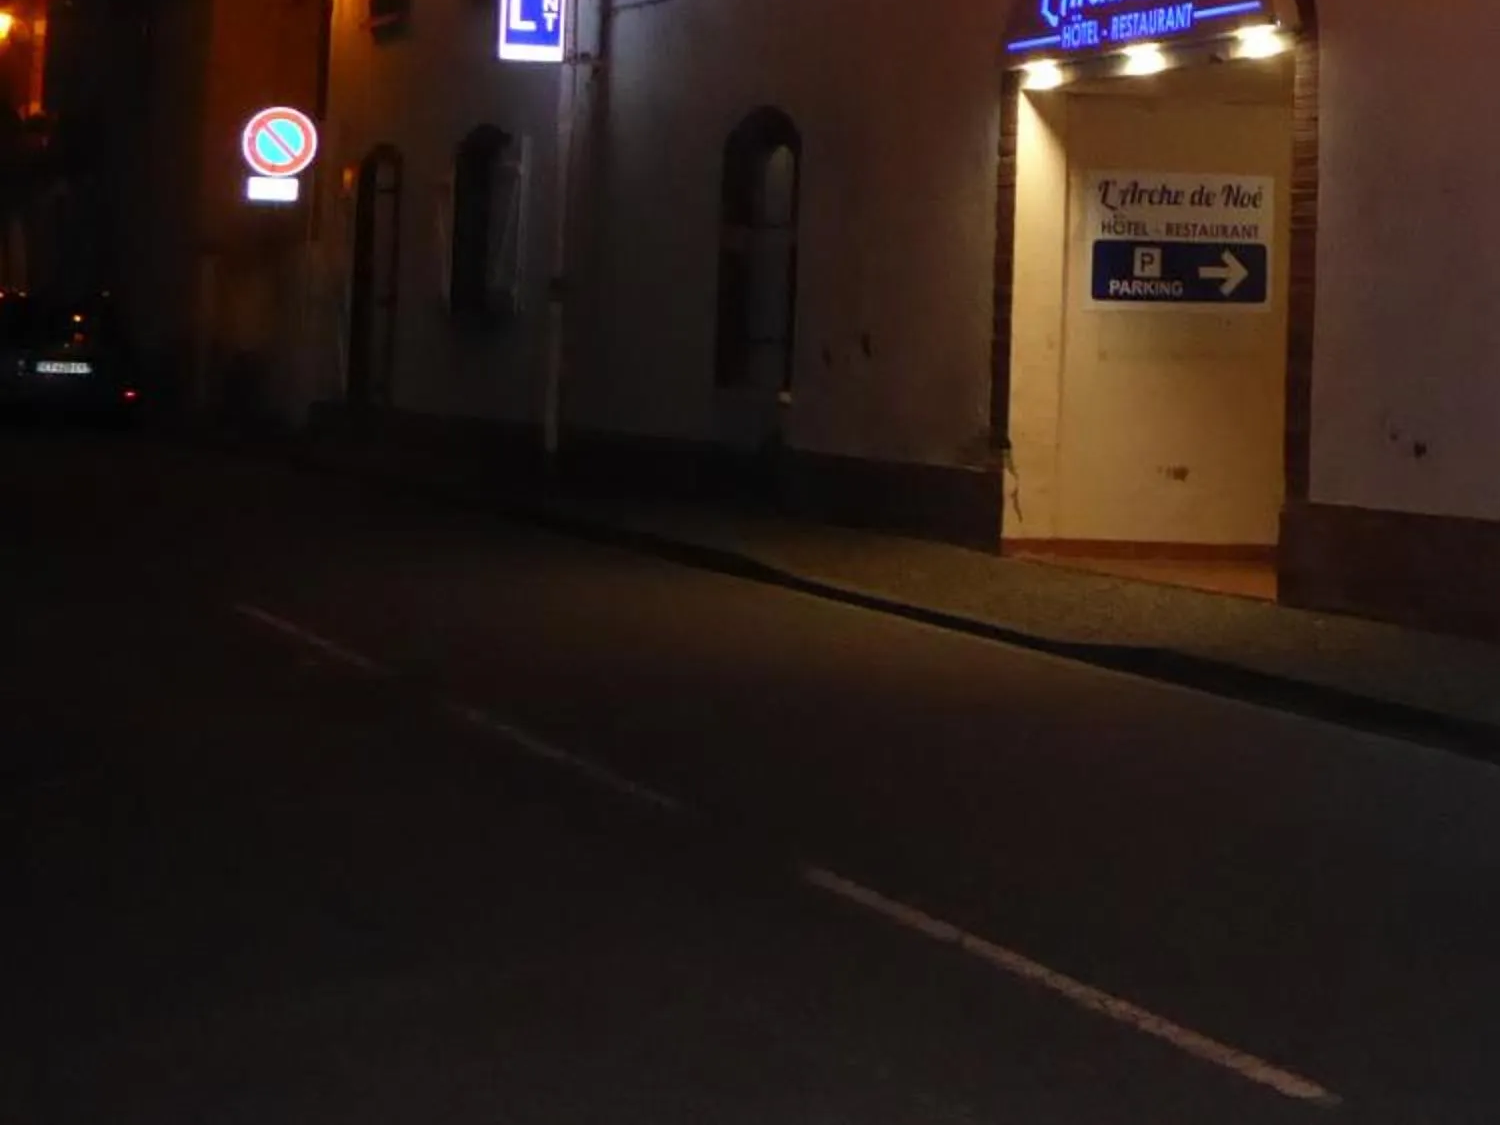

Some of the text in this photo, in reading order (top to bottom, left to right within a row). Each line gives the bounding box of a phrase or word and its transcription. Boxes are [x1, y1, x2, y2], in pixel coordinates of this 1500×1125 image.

[1110, 3, 1193, 41] RESTAURANT
[1099, 180, 1264, 211] L'Arche de Noé
[1165, 222, 1259, 239] RESTAURANT
[1140, 252, 1154, 273] P
[1109, 280, 1184, 297] PARKING
